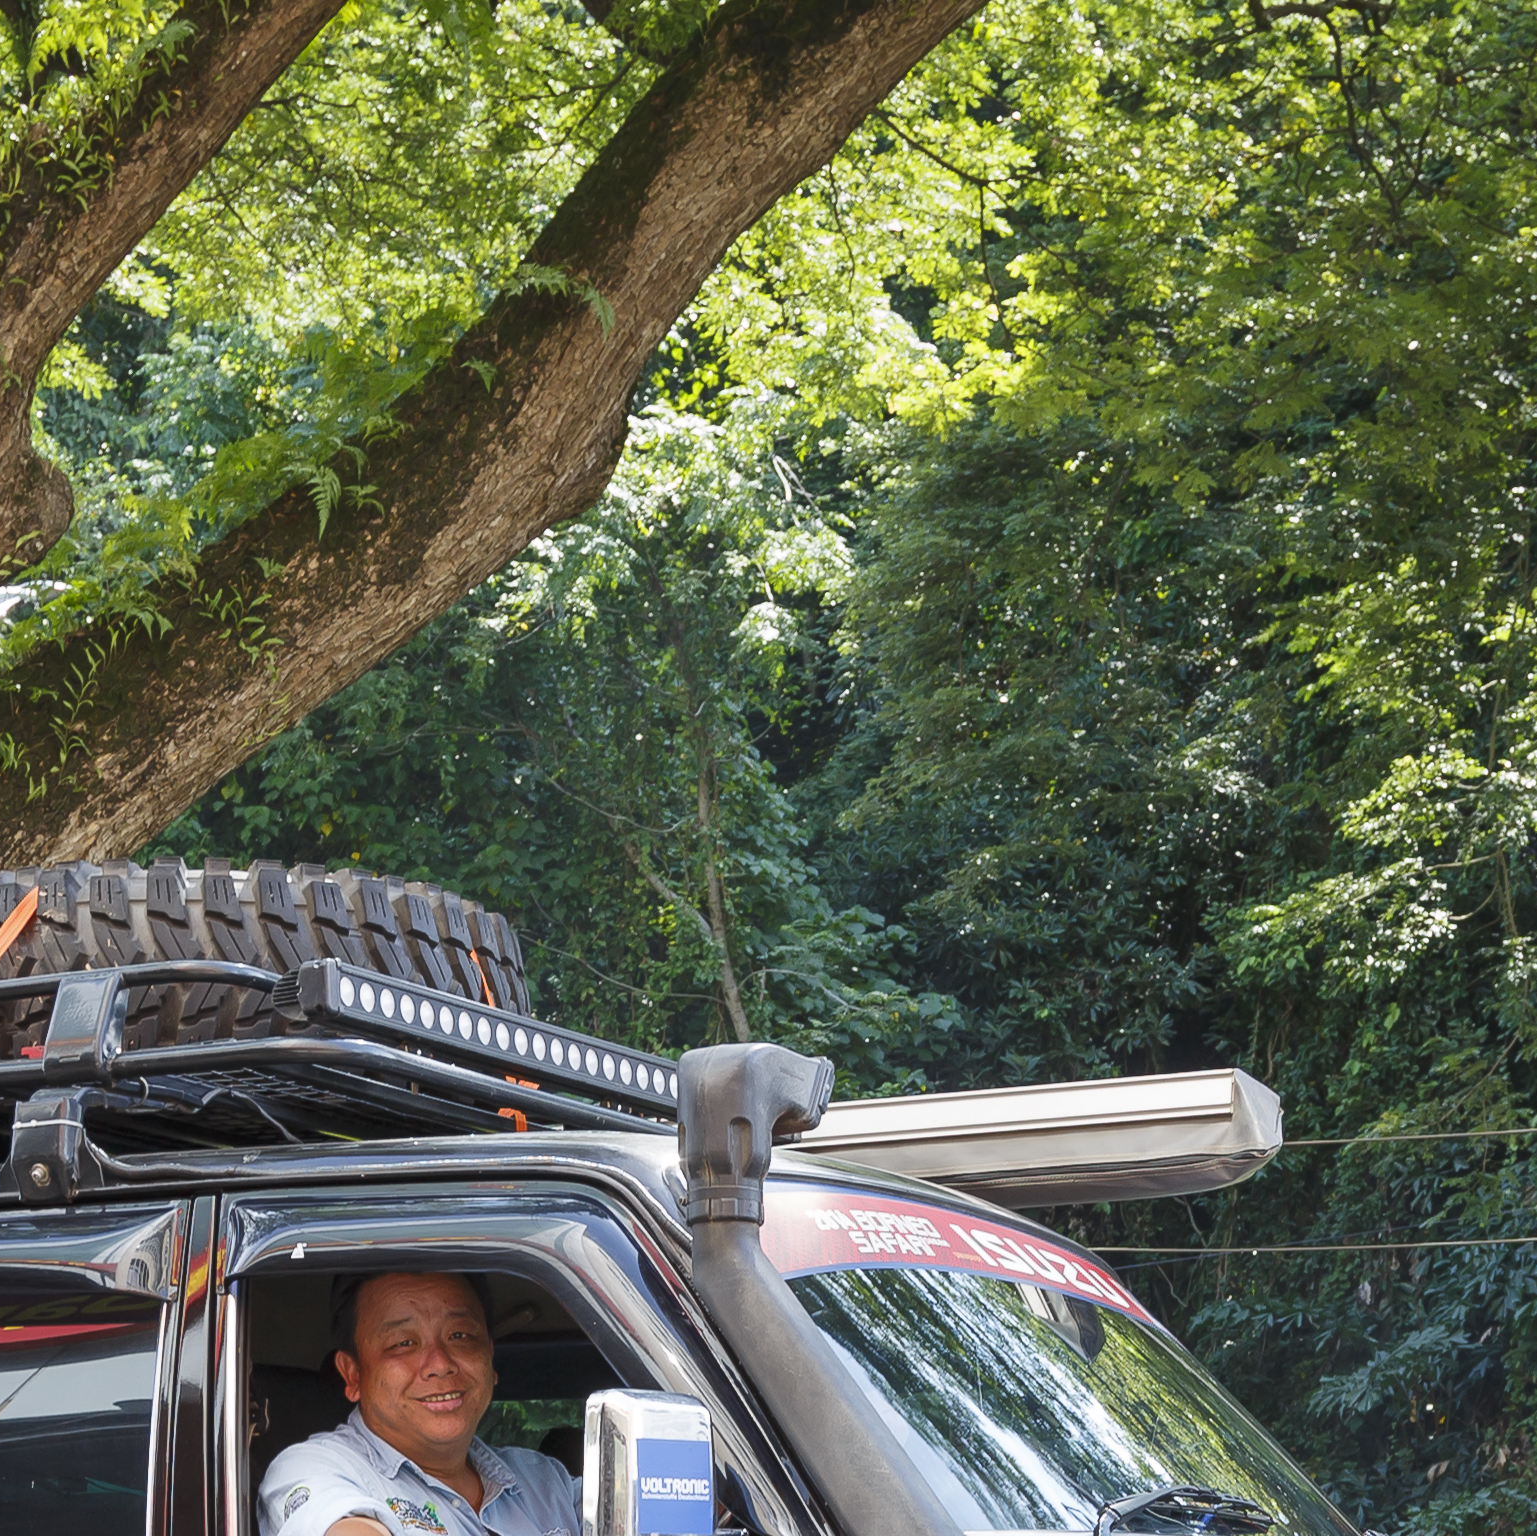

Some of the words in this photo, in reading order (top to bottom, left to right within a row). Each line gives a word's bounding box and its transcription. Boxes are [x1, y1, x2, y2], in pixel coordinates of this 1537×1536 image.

[849, 1209, 941, 1239] BORNEO
[848, 1231, 936, 1257] SAFARI
[949, 1222, 1131, 1310] ISUZU
[641, 1477, 709, 1496] VOLTRONIC
